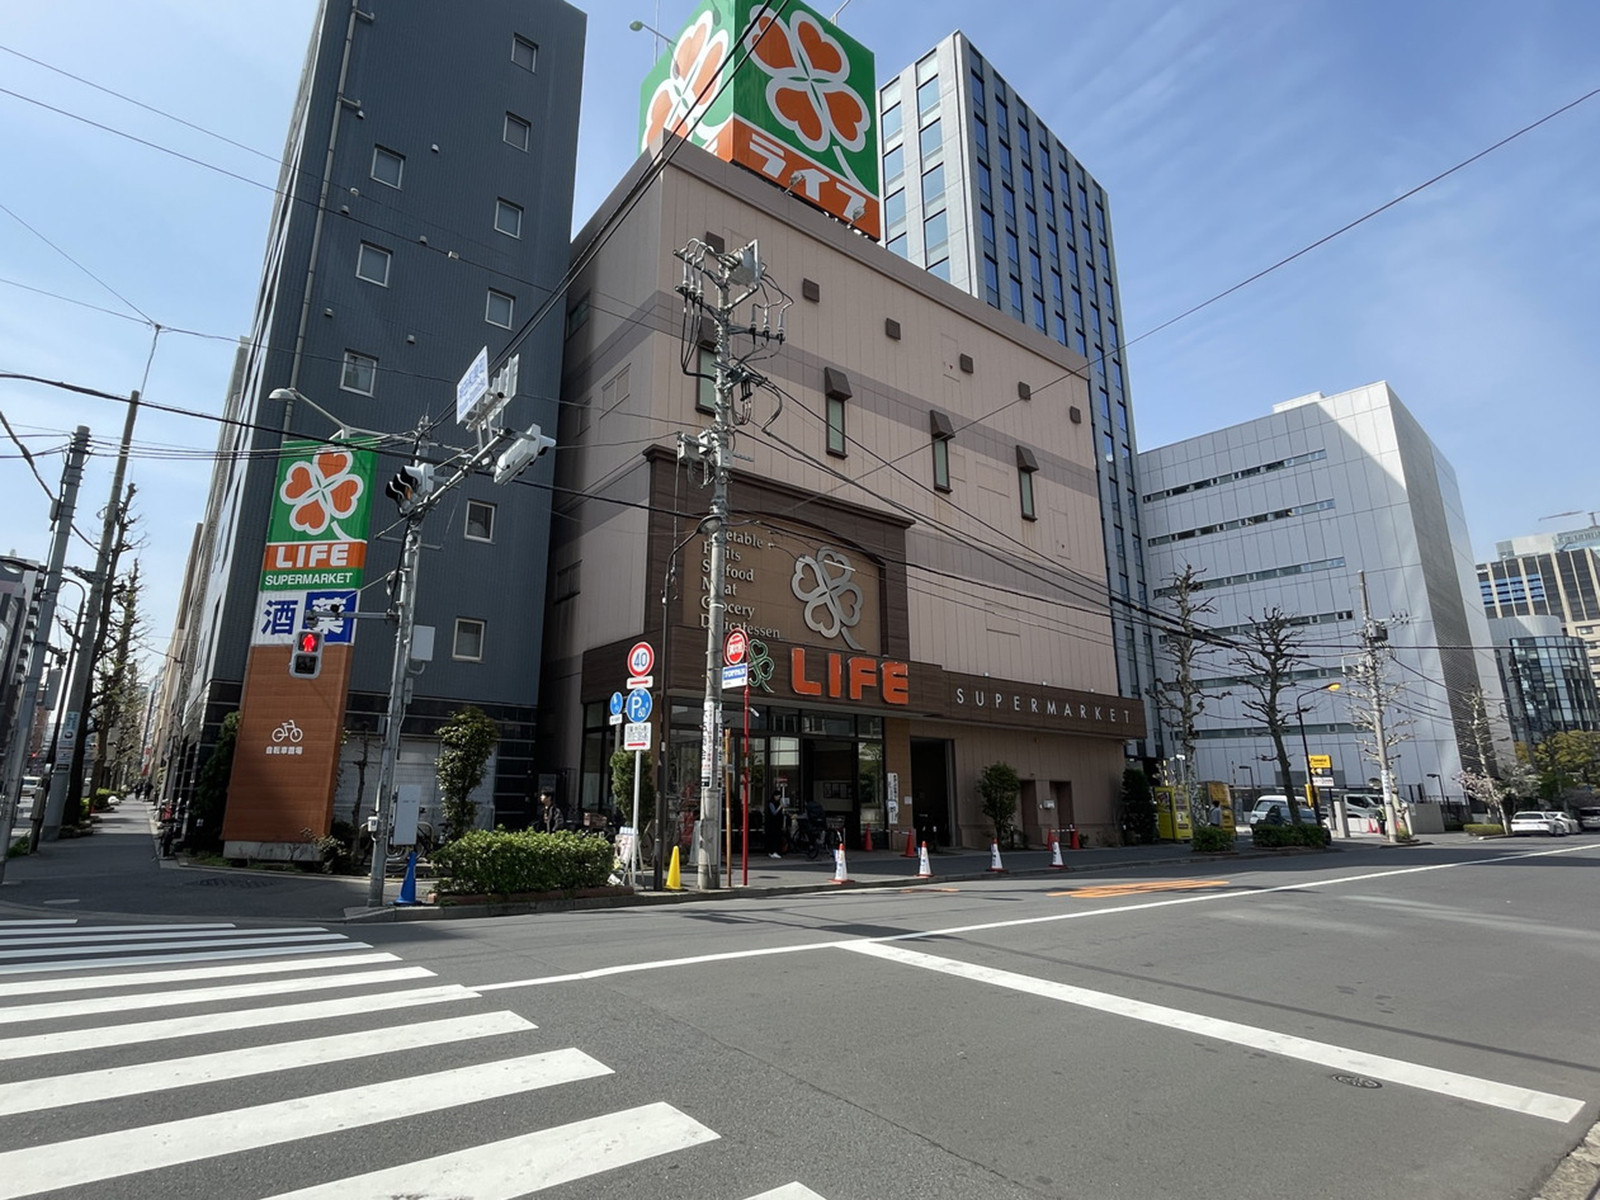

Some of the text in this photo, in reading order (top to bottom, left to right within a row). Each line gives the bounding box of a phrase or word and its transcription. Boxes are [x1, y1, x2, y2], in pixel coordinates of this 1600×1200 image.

[749, 133, 867, 221] ライフ
[275, 544, 349, 568] LIFE
[702, 559, 754, 582] Sfood
[265, 573, 353, 586] SUPERMARKET
[261, 600, 298, 635] 酒
[634, 652, 648, 667] 40
[791, 647, 909, 705] LIFE
[956, 688, 1131, 724] SUPERMARKET
